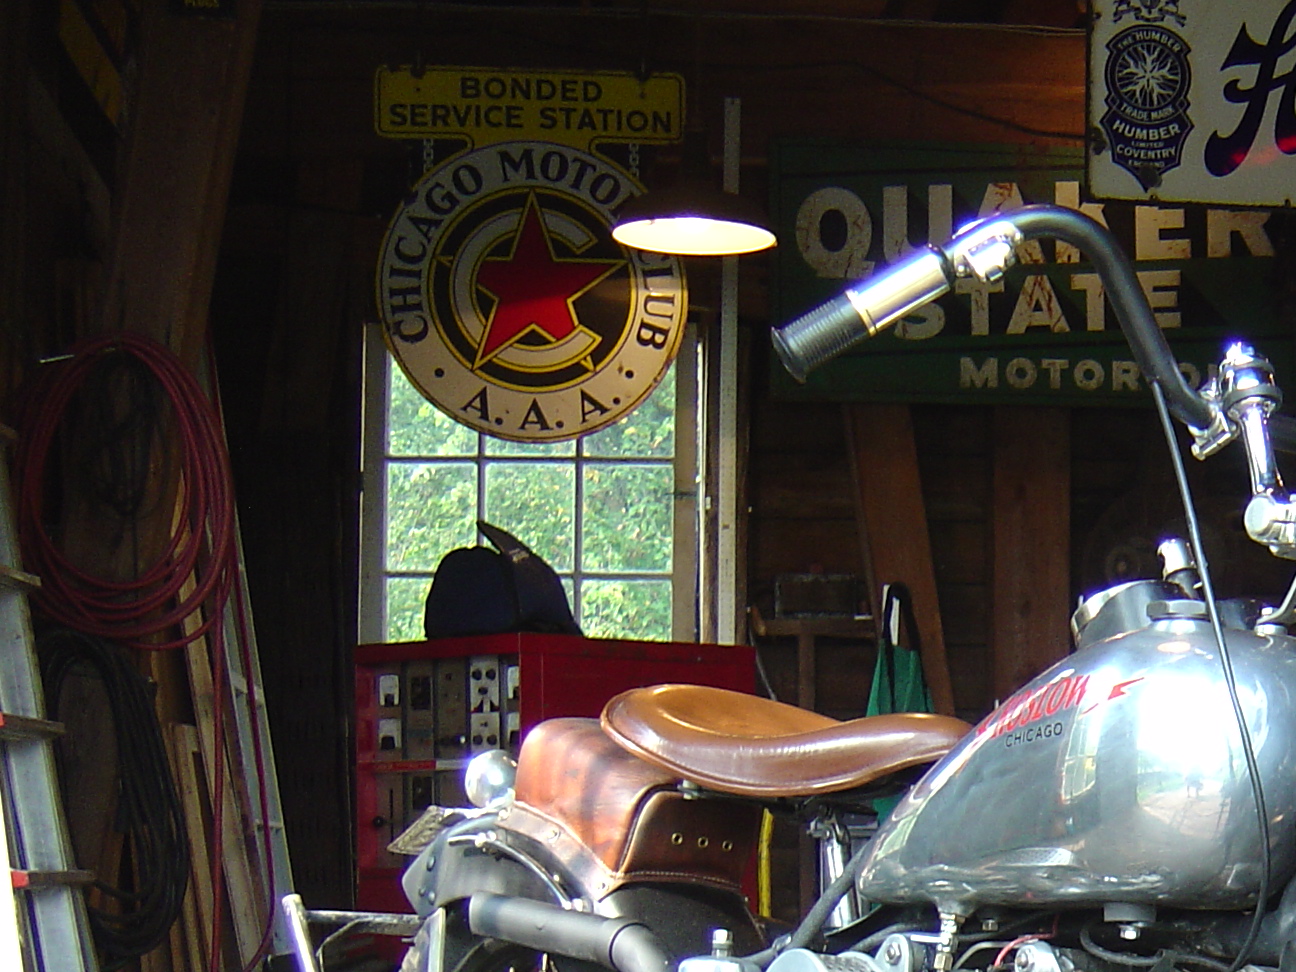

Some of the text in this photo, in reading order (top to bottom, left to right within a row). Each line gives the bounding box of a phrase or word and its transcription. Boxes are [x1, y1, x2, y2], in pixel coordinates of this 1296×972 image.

[1135, 29, 1183, 53] HUMBER
[460, 76, 603, 103] BONDED
[388, 103, 672, 134] SERVICE STATION
[1120, 101, 1150, 121] TRADE
[1112, 120, 1181, 141] HUMBER
[1116, 143, 1177, 160] COVENTRY
[388, 164, 484, 344] CHICAGO
[498, 147, 636, 219] MOTO
[959, 355, 1142, 391] MOTOR
[1005, 721, 1063, 748] CHICAGO
